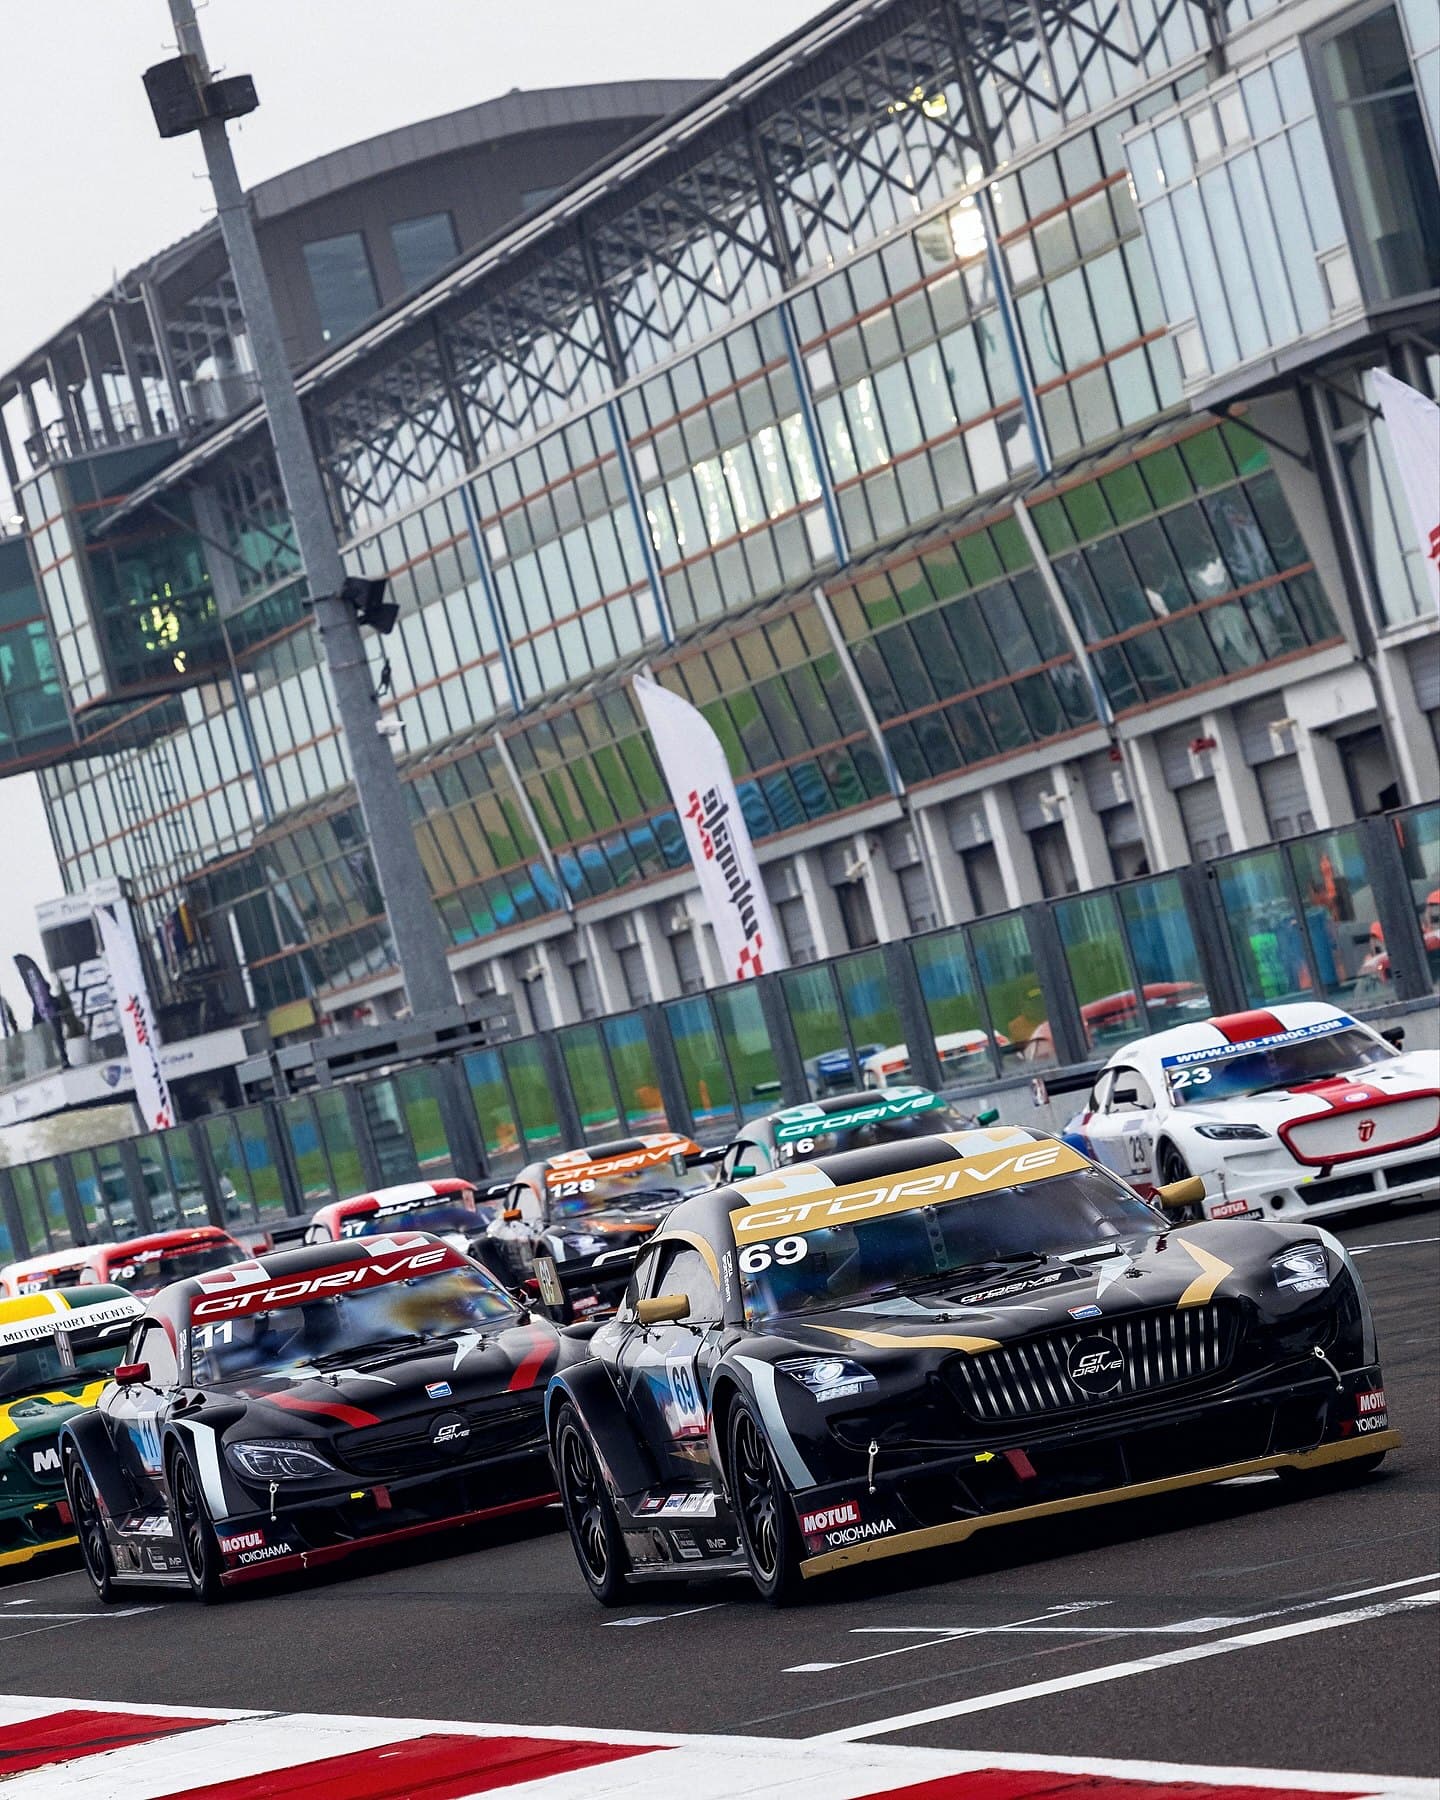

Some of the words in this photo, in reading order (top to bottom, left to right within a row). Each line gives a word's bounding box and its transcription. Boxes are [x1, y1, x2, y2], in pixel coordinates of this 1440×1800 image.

[1171, 1067, 1212, 1090] 23
[778, 1095, 935, 1137] GTDRIVE
[780, 1138, 815, 1157] 16
[1129, 1136, 1145, 1162] 23
[549, 1178, 596, 1198] 128
[737, 1146, 1060, 1232] GTDRIVE
[1213, 1202, 1246, 1217] MOTUL
[342, 1221, 367, 1237] 17
[739, 1235, 808, 1274] 69
[109, 1265, 136, 1281] 76
[194, 1247, 447, 1316] GTDRIVE
[3, 1317, 86, 1343] MOTORSPORT
[89, 1305, 135, 1321] EVENTS
[195, 1320, 234, 1349] 11
[1072, 1360, 1123, 1378] DRIVE
[1079, 1350, 1111, 1368] GT
[671, 1366, 696, 1416] 69
[143, 1421, 161, 1459] 11
[432, 1429, 471, 1444] DRIVE
[438, 1423, 461, 1436] GT
[803, 1504, 858, 1533] MOTUL
[221, 1532, 263, 1553] MOTUL
[825, 1518, 896, 1546] YOKOHAMA
[238, 1542, 292, 1565] YOKOHAMA
